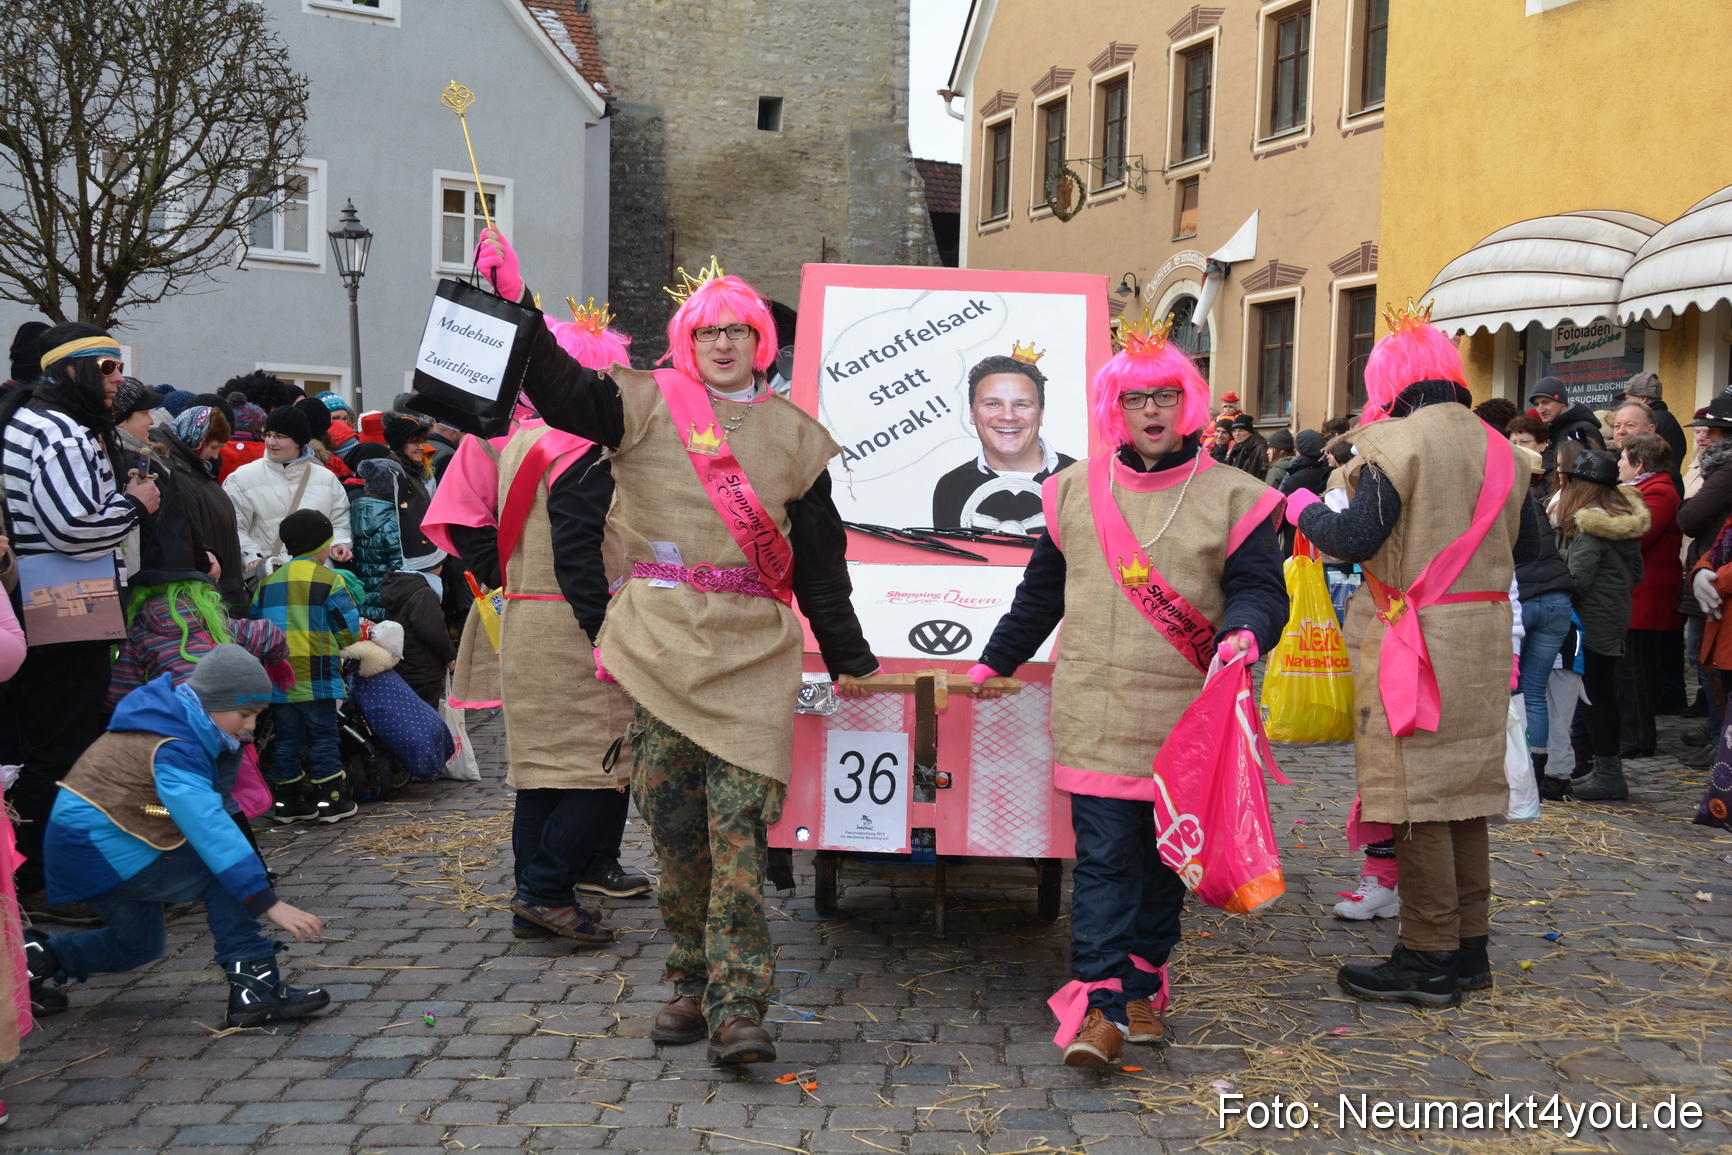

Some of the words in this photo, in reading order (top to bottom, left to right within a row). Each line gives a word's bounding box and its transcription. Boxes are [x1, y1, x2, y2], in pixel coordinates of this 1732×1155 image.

[437, 316, 505, 349] Modehaus
[825, 298, 992, 383] Kartoffelsack
[1557, 322, 1612, 341] Fotoladen
[1563, 331, 1622, 360] Christine
[424, 350, 496, 384] Zwittlinger
[1557, 361, 1591, 373] DIGITALE
[868, 366, 931, 407] statt
[1572, 385, 1585, 394] AM
[843, 395, 952, 466] Anorak!!
[725, 474, 765, 532] Shopping
[885, 590, 942, 600] Shopping
[943, 589, 1002, 610] Queen
[1146, 584, 1199, 634] Shopping
[833, 750, 899, 805] 36
